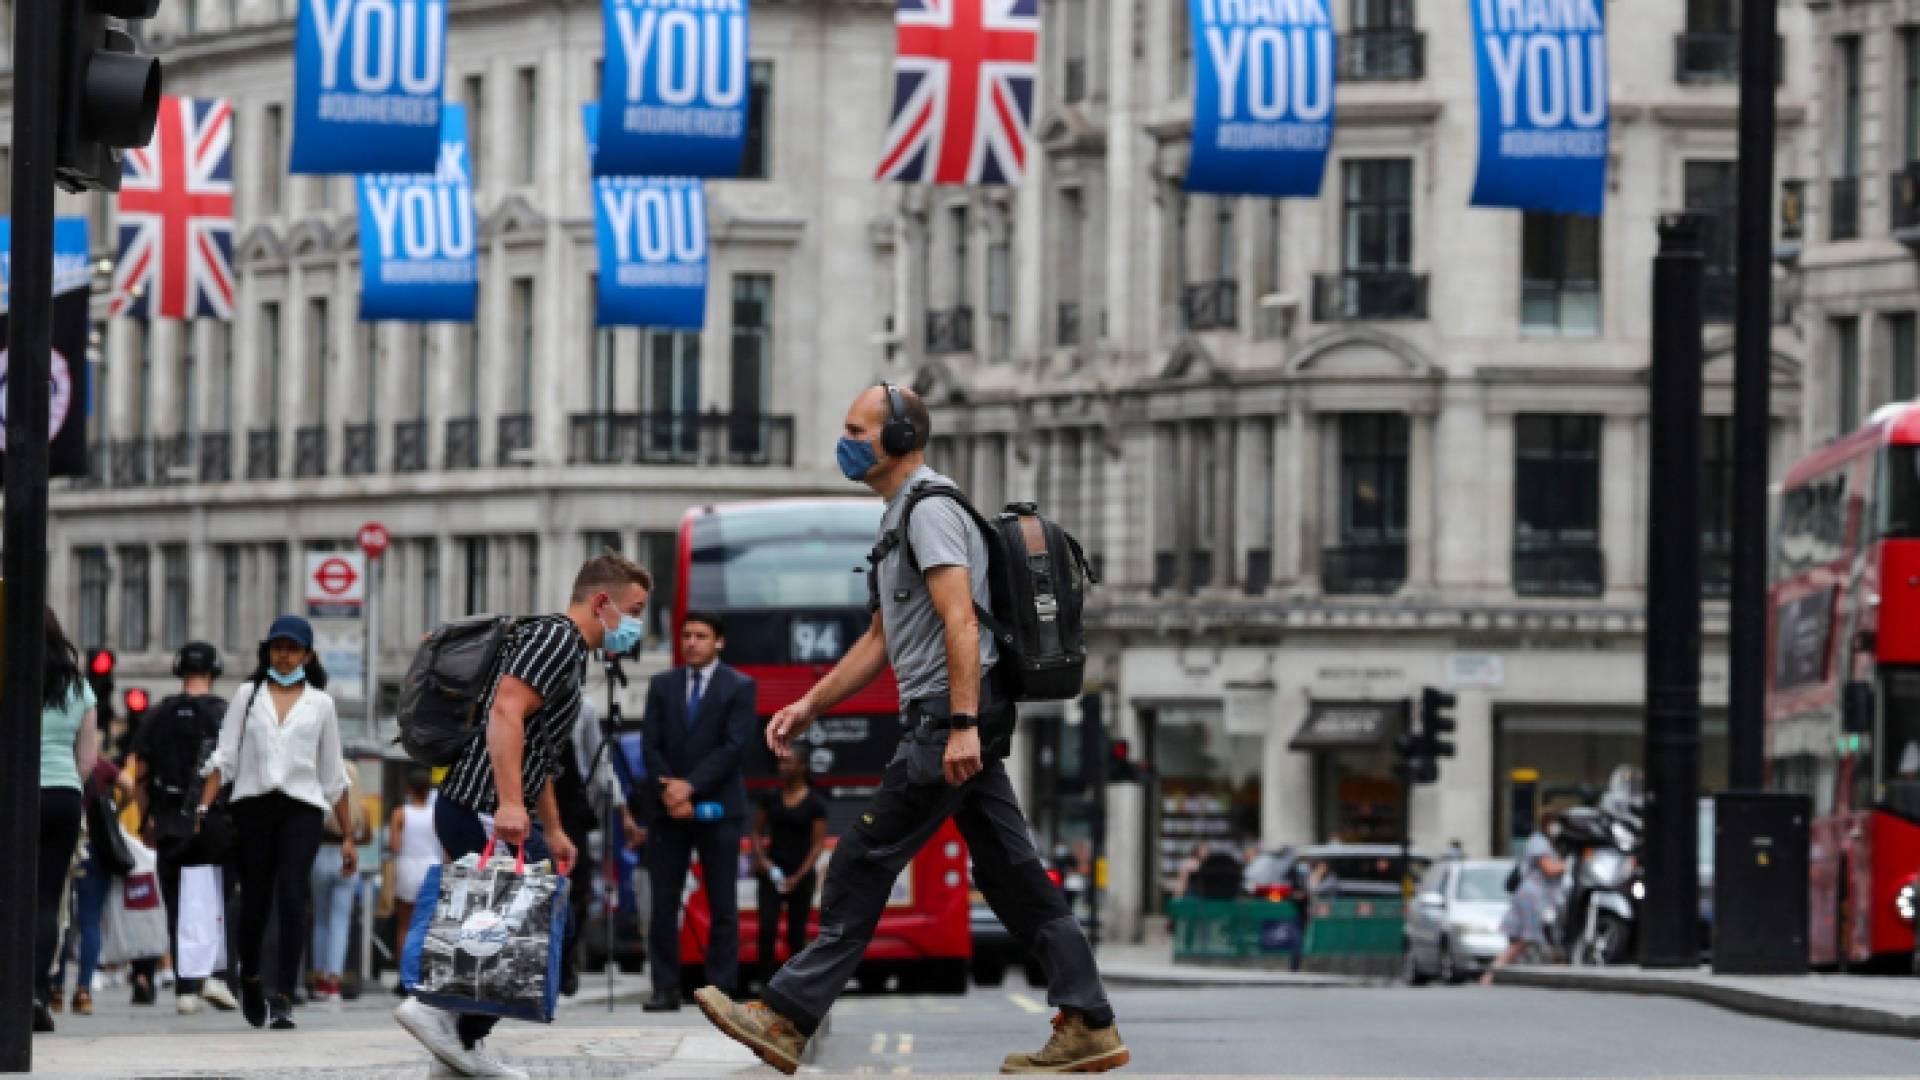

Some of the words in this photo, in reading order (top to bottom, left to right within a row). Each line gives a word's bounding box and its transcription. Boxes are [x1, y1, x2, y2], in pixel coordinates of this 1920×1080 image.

[311, 0, 441, 93] YOU
[616, 7, 744, 107] YOU
[1205, 26, 1331, 121] YOU
[1485, 33, 1606, 128] YOU
[365, 184, 475, 259] YOU
[602, 187, 705, 262] YOU
[794, 621, 841, 661] 94
